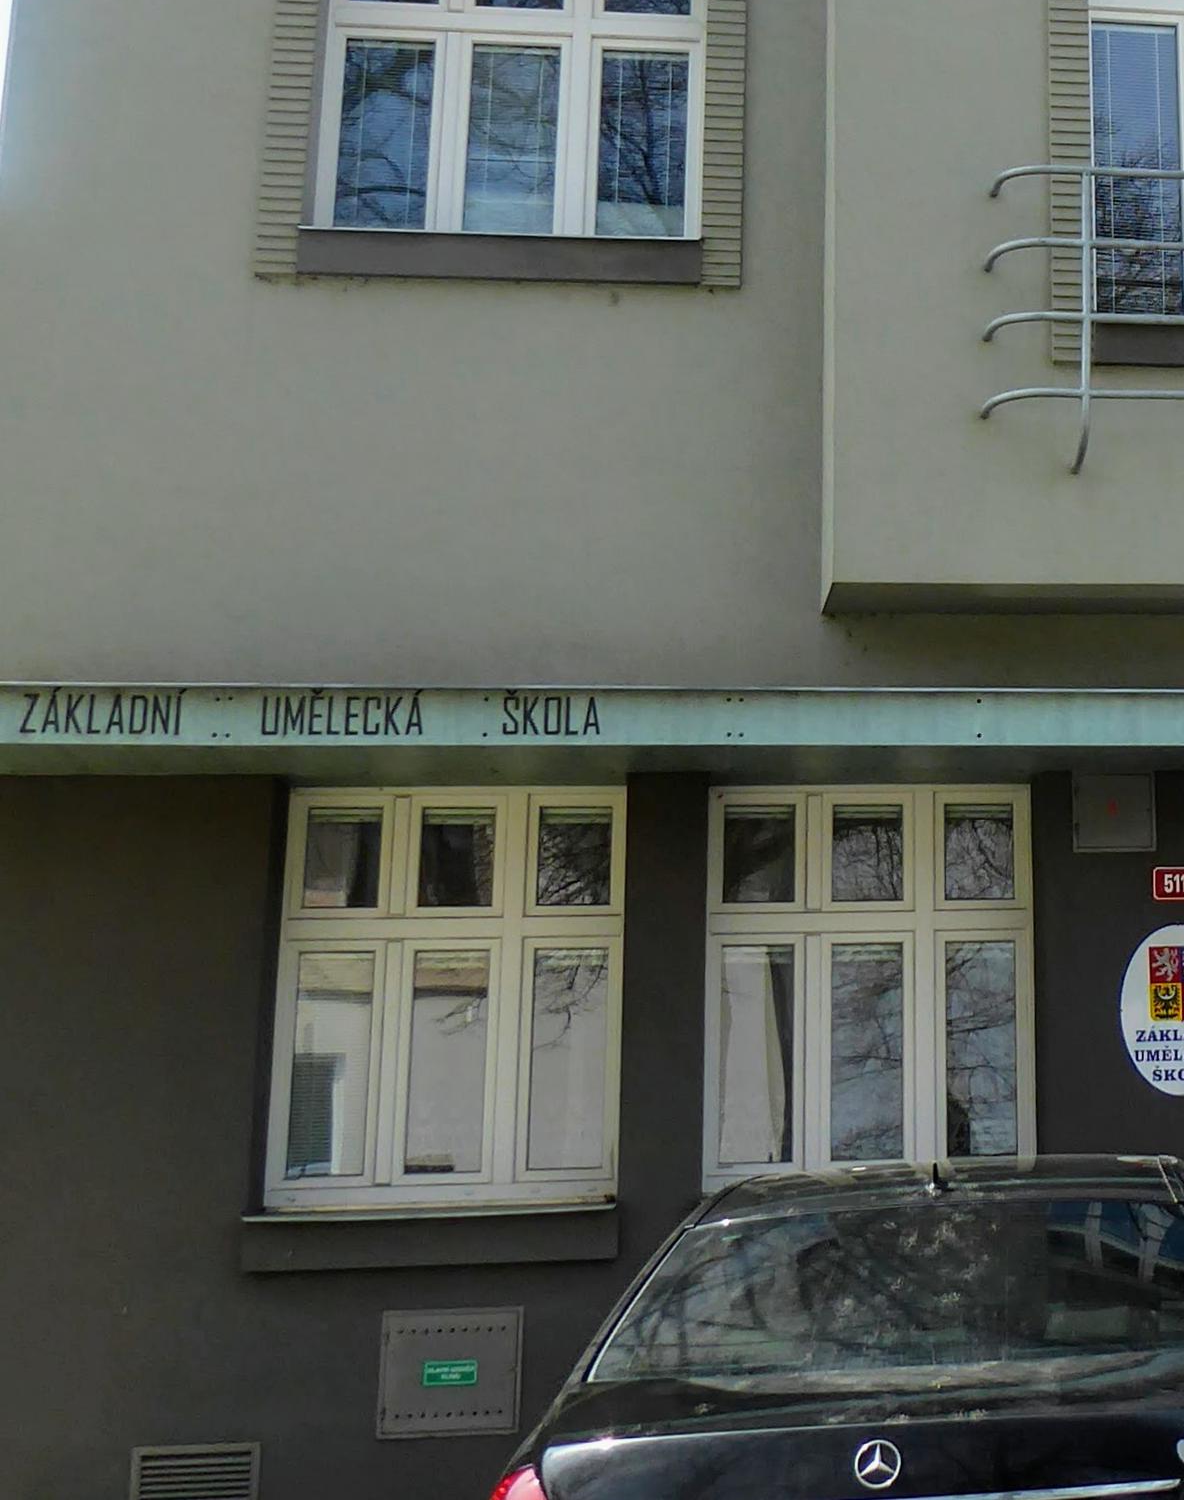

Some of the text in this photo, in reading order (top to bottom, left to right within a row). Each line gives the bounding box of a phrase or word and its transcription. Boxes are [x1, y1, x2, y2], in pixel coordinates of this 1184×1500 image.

[19, 687, 601, 736] ZÁKLADNÍ UMĚLECKÁ ŠKOLA
